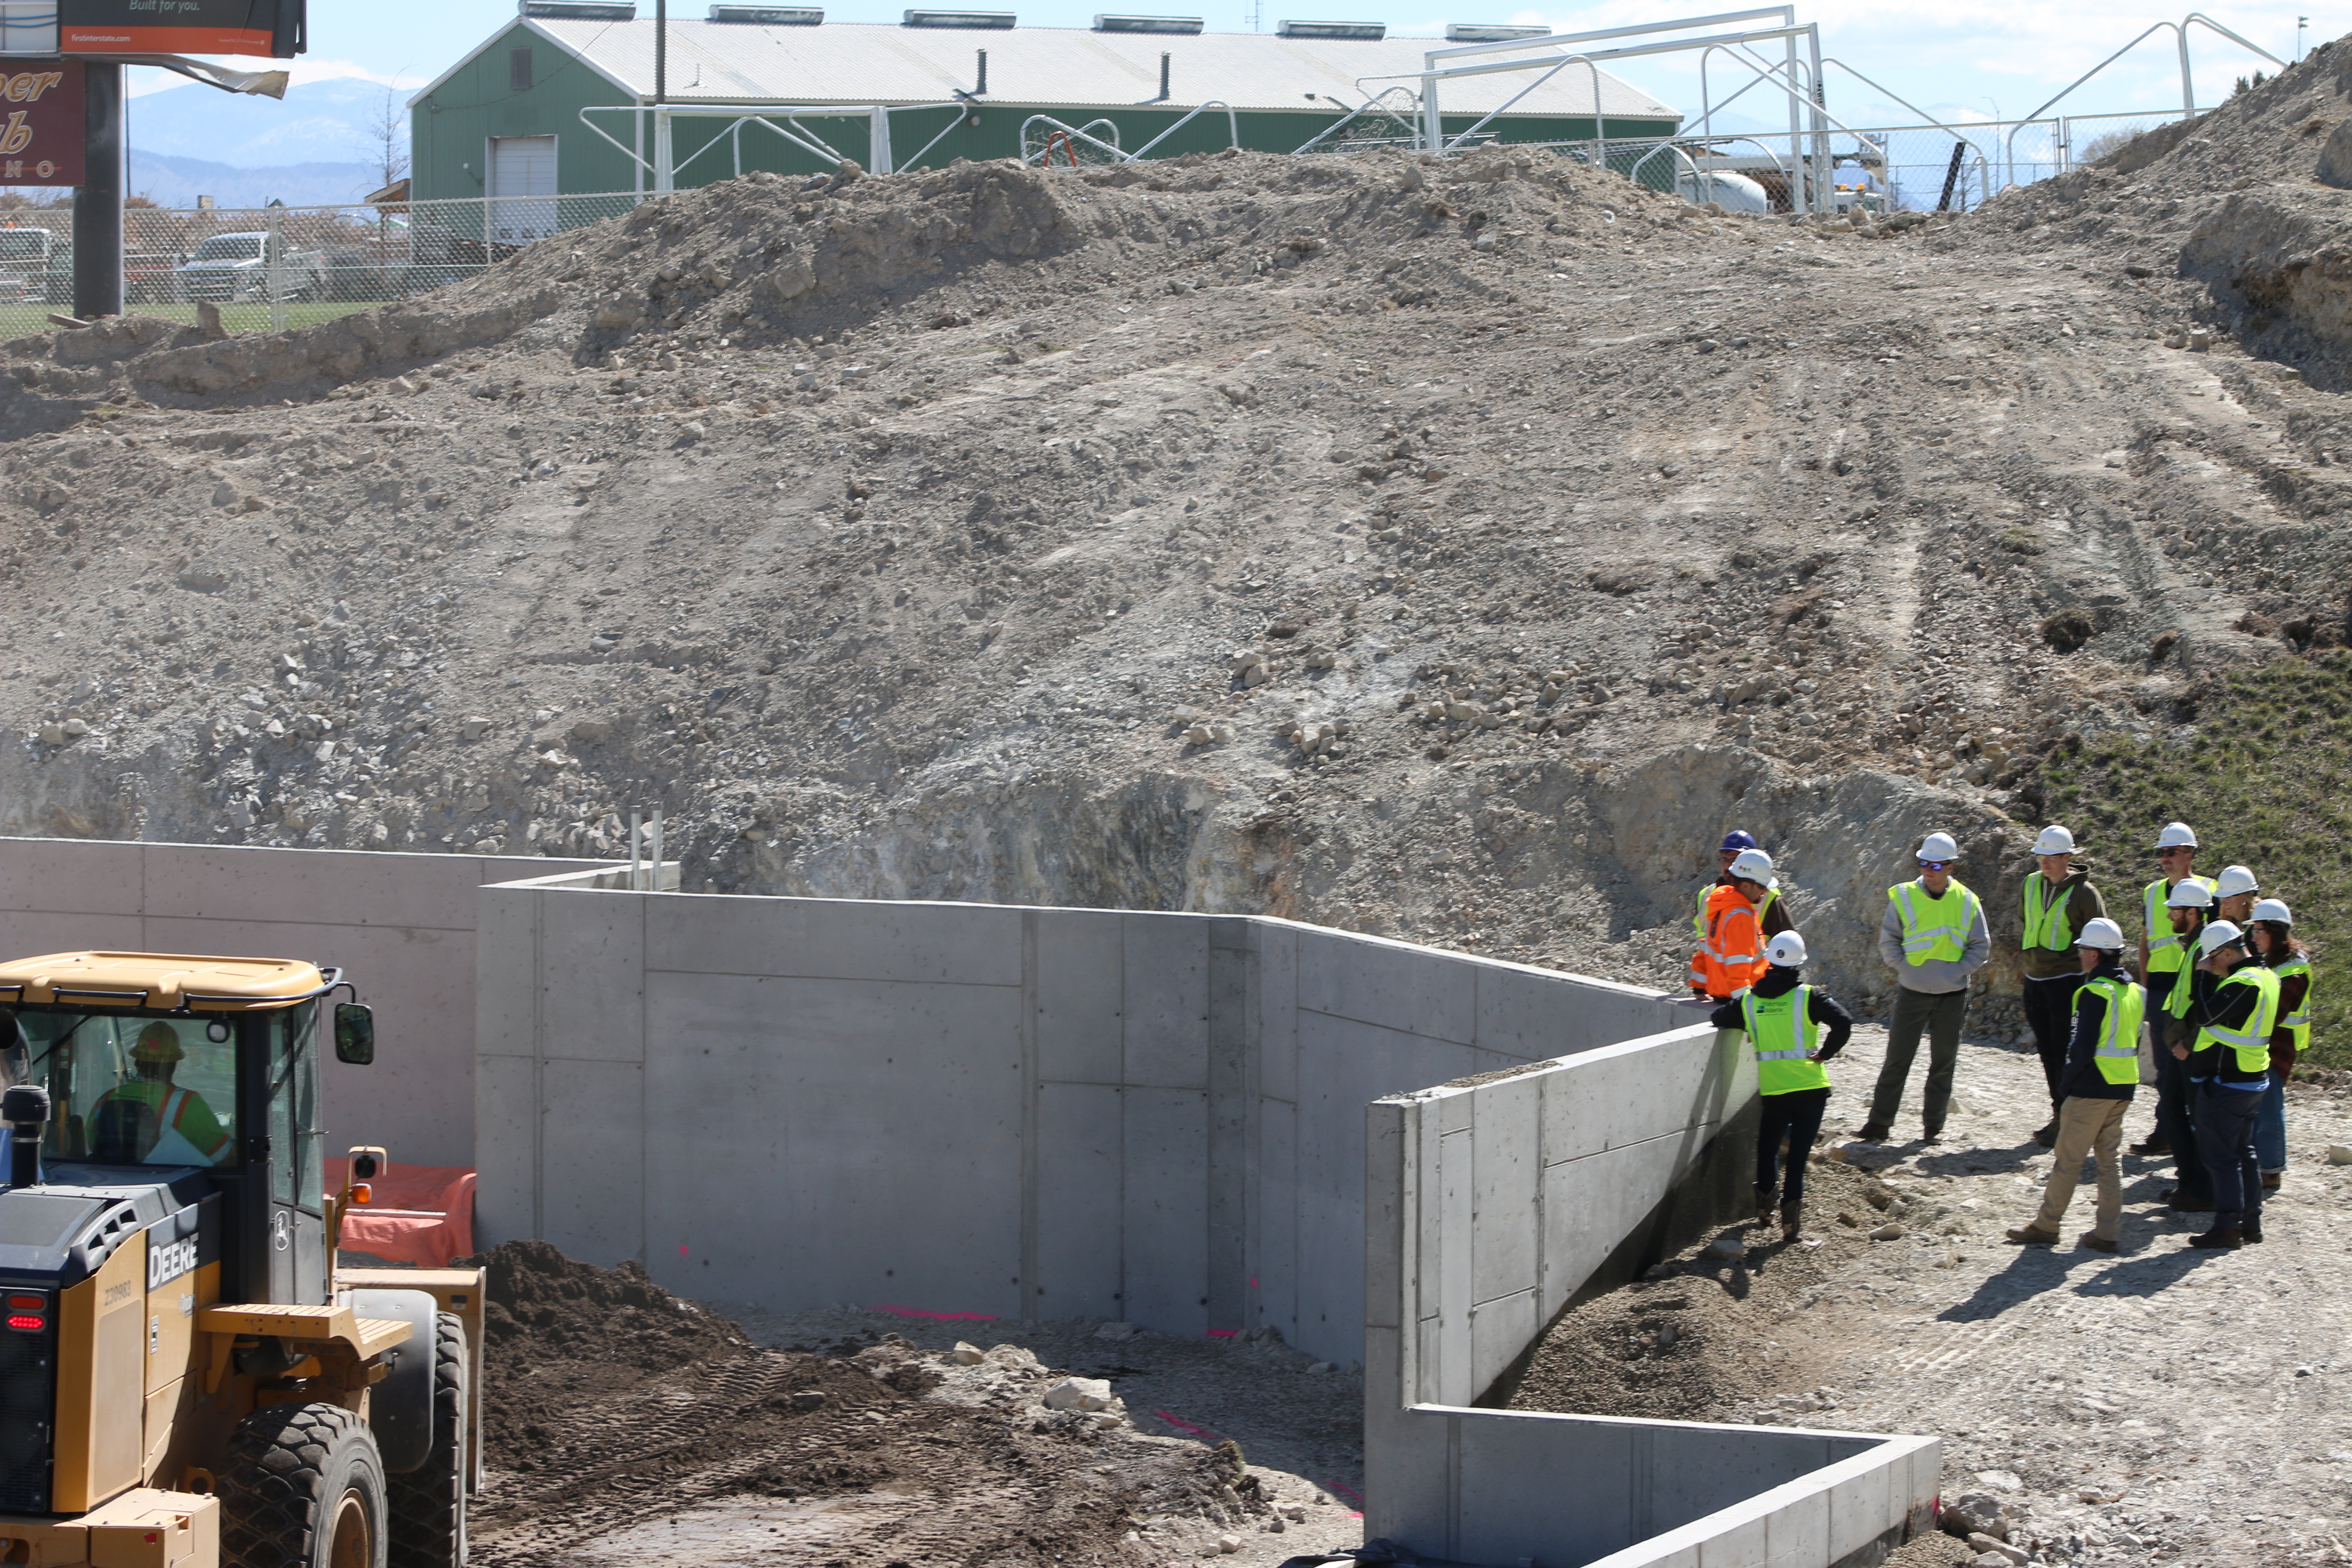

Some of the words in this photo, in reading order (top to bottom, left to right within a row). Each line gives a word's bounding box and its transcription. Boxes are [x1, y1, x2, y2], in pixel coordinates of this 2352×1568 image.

[129, 0, 156, 10] Built
[159, 0, 176, 14] for
[178, 2, 200, 14] you.
[149, 1232, 199, 1289] DEERE
